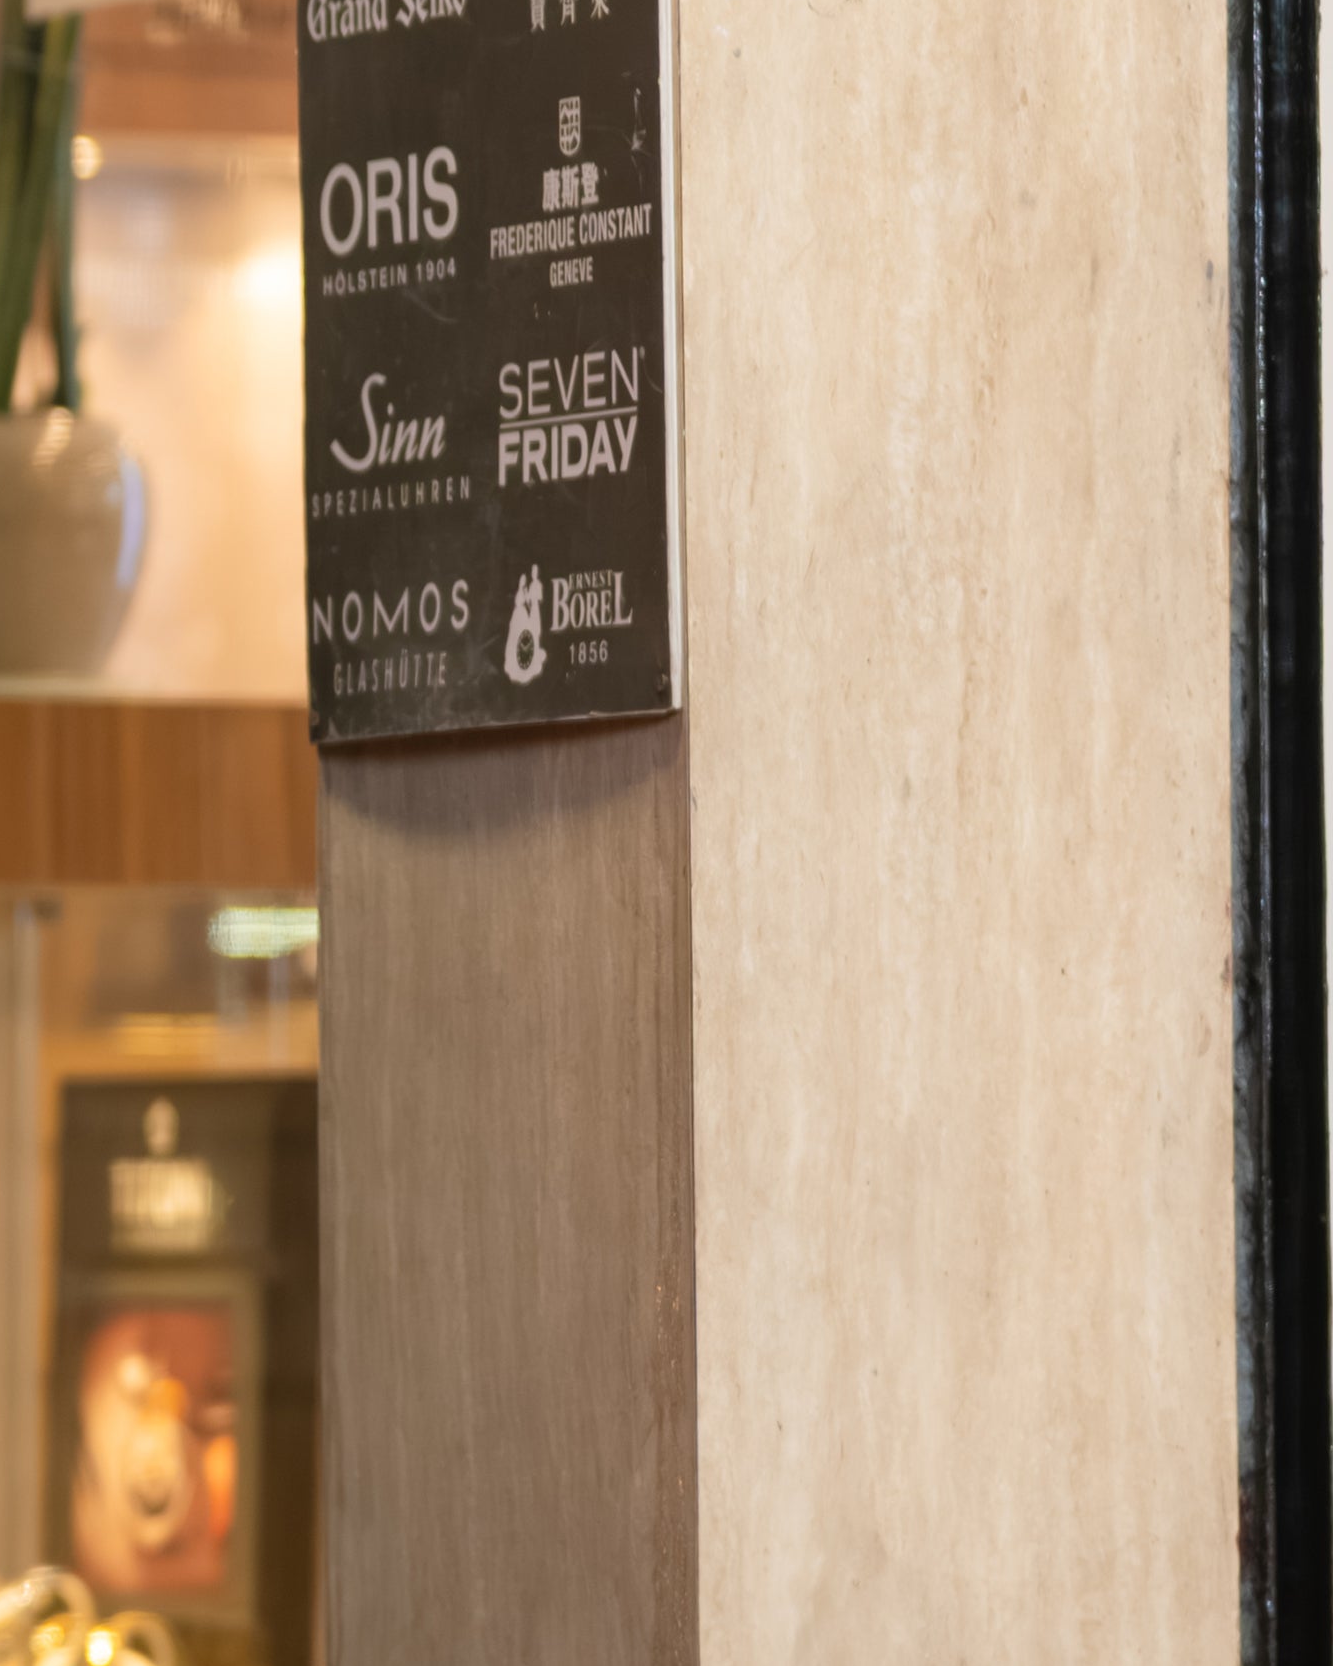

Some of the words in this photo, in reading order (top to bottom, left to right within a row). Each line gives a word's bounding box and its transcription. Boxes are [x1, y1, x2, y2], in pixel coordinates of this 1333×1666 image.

[320, 146, 459, 257] ORIS
[489, 216, 576, 260] FREDERIQUE
[578, 203, 653, 246] CONSTANT
[415, 256, 456, 283] 1904
[549, 256, 594, 288] GENEVE
[498, 346, 640, 420] SEVEN
[330, 372, 446, 473] Sinn
[498, 414, 638, 488] FRIDAY
[311, 475, 471, 519] SPEZIALUHREN
[549, 570, 633, 632] BOREL
[568, 568, 613, 590] ERNEST
[311, 578, 470, 645] NOMOS
[333, 648, 447, 697] GLASHÜTTE
[569, 639, 609, 666] 1856
